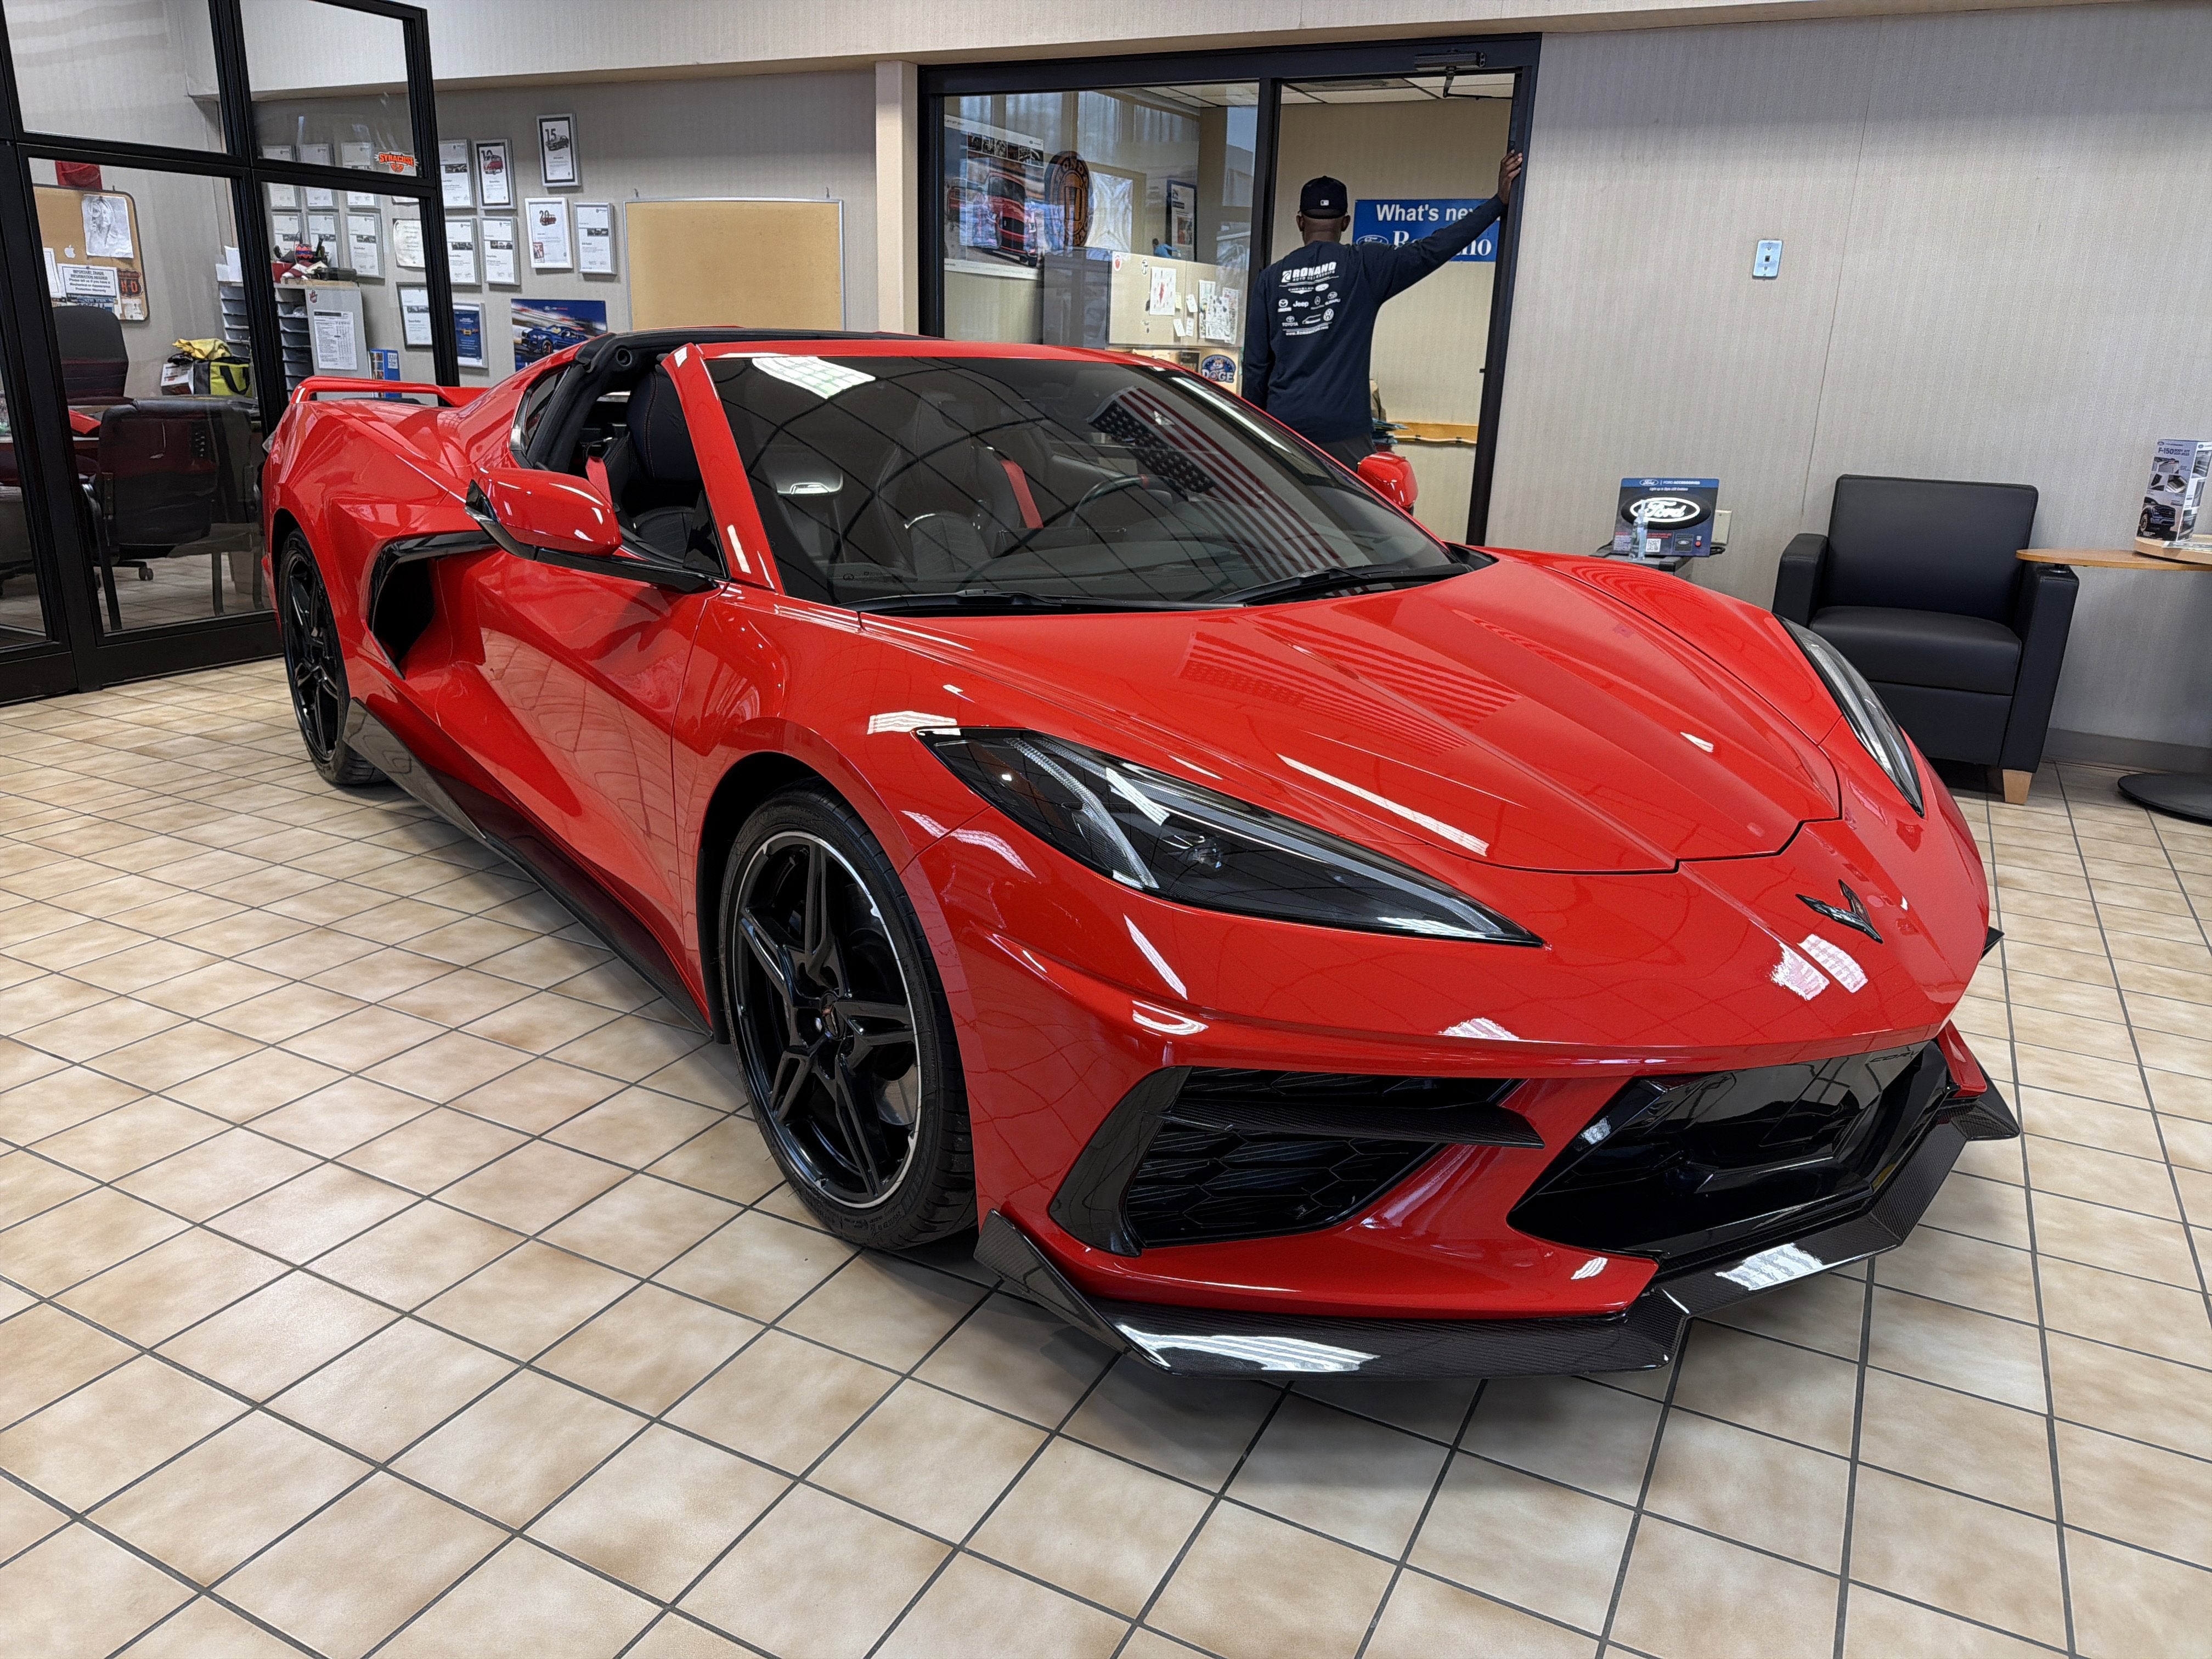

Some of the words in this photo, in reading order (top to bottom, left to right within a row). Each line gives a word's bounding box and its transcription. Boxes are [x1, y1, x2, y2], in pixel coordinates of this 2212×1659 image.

[545, 128, 557, 142] 15
[379, 154, 414, 167] SYRACUSE
[1376, 204, 1439, 222] What's
[1445, 207, 1474, 222] ne
[1293, 262, 1336, 278] ROMANO
[1202, 369, 1233, 382] DOGE
[1644, 501, 1687, 517] Ford
